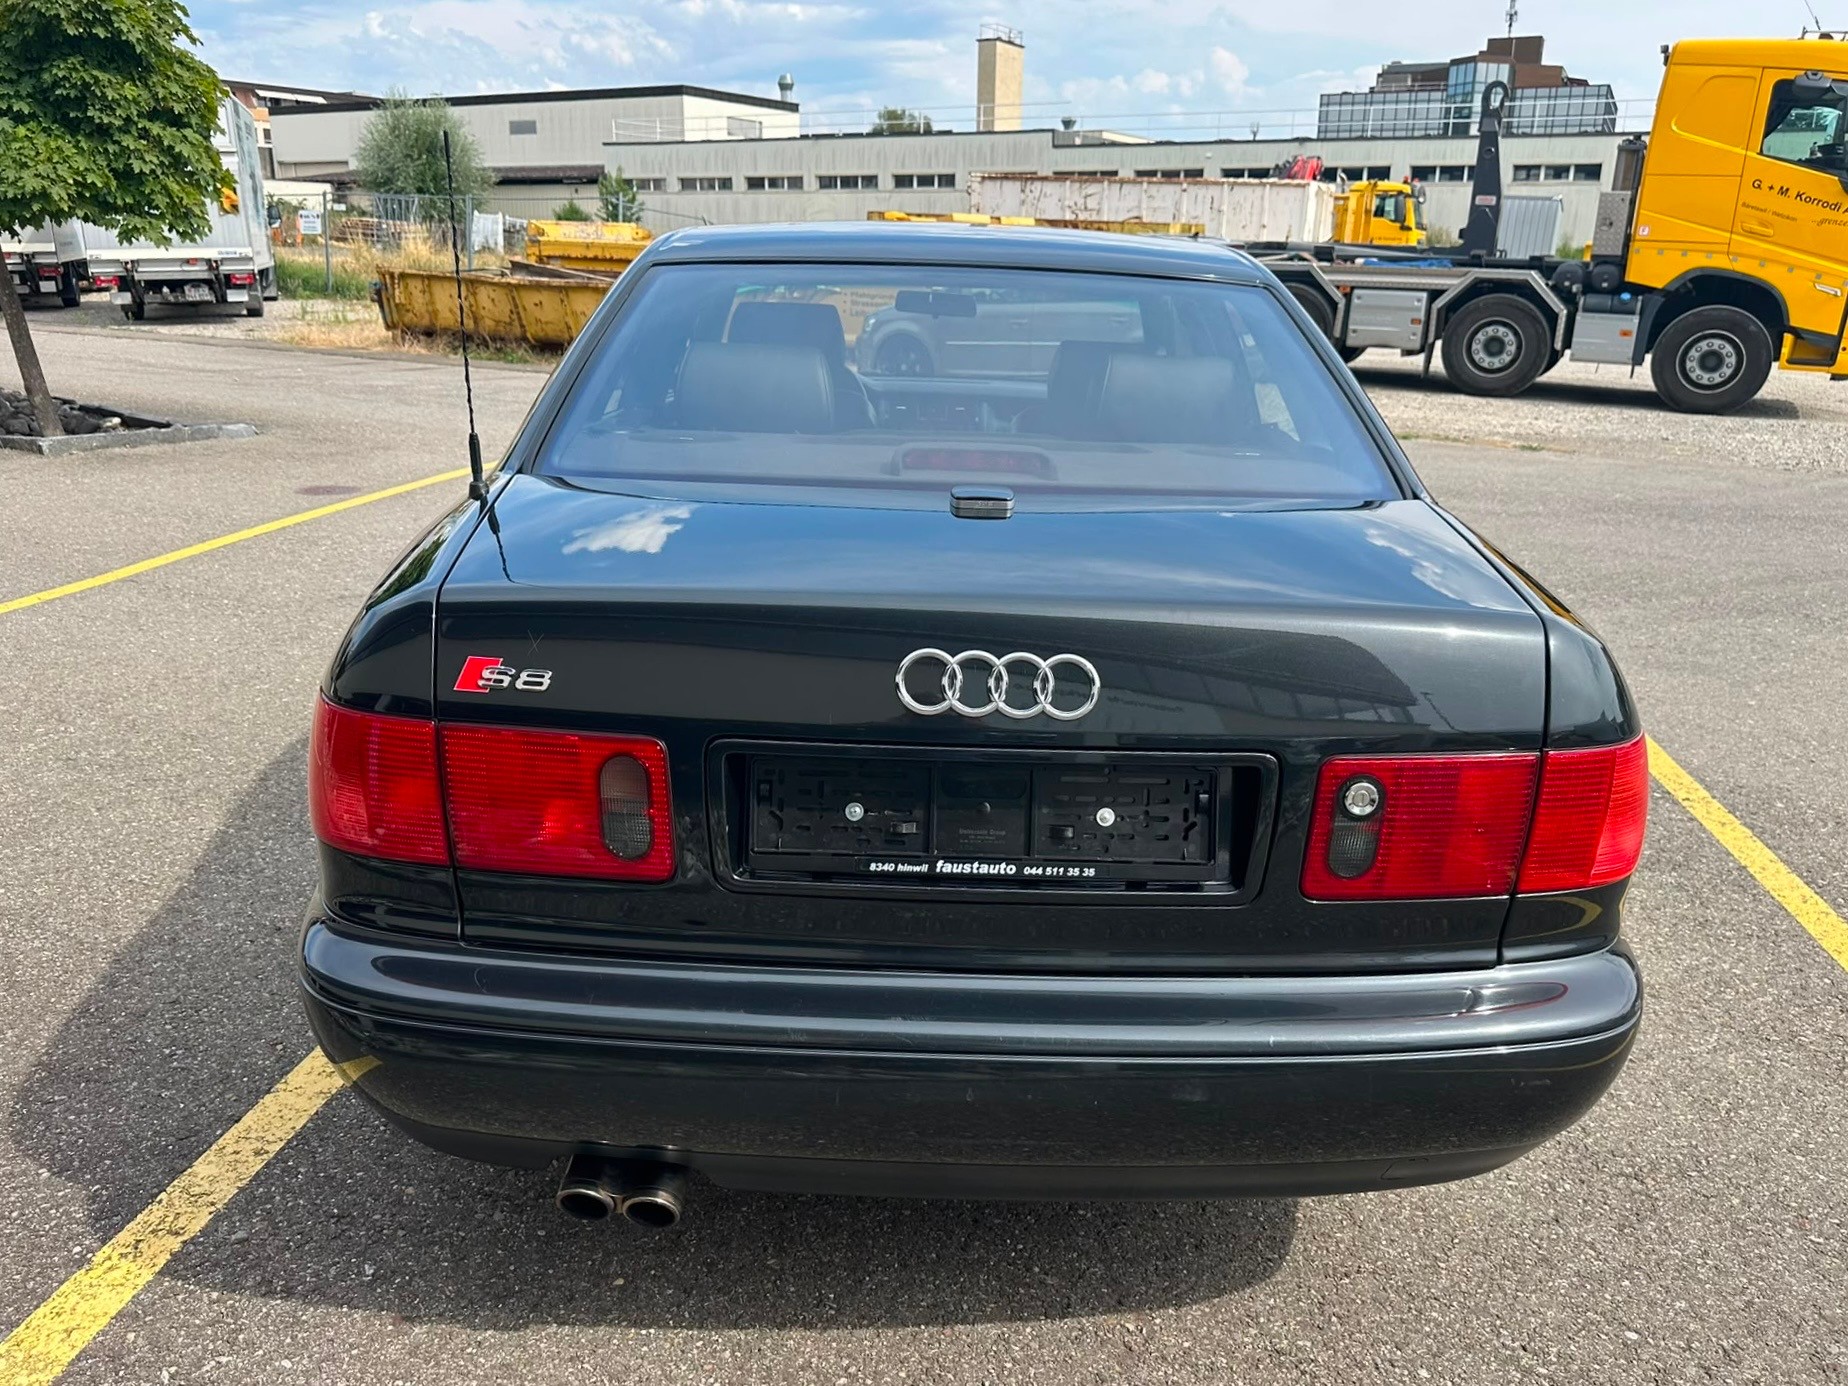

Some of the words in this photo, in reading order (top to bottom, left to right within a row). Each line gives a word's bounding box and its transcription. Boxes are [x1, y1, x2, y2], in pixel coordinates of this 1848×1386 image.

[1795, 190, 1842, 212] Korrodi
[477, 665, 552, 691] S8
[869, 862, 895, 872] 8340
[897, 863, 929, 873] hinwil
[936, 859, 1017, 875] faustauto
[1023, 866, 1043, 875] 044
[1045, 866, 1065, 876] 511
[1067, 867, 1080, 877] 35
[1082, 867, 1096, 877] 35
